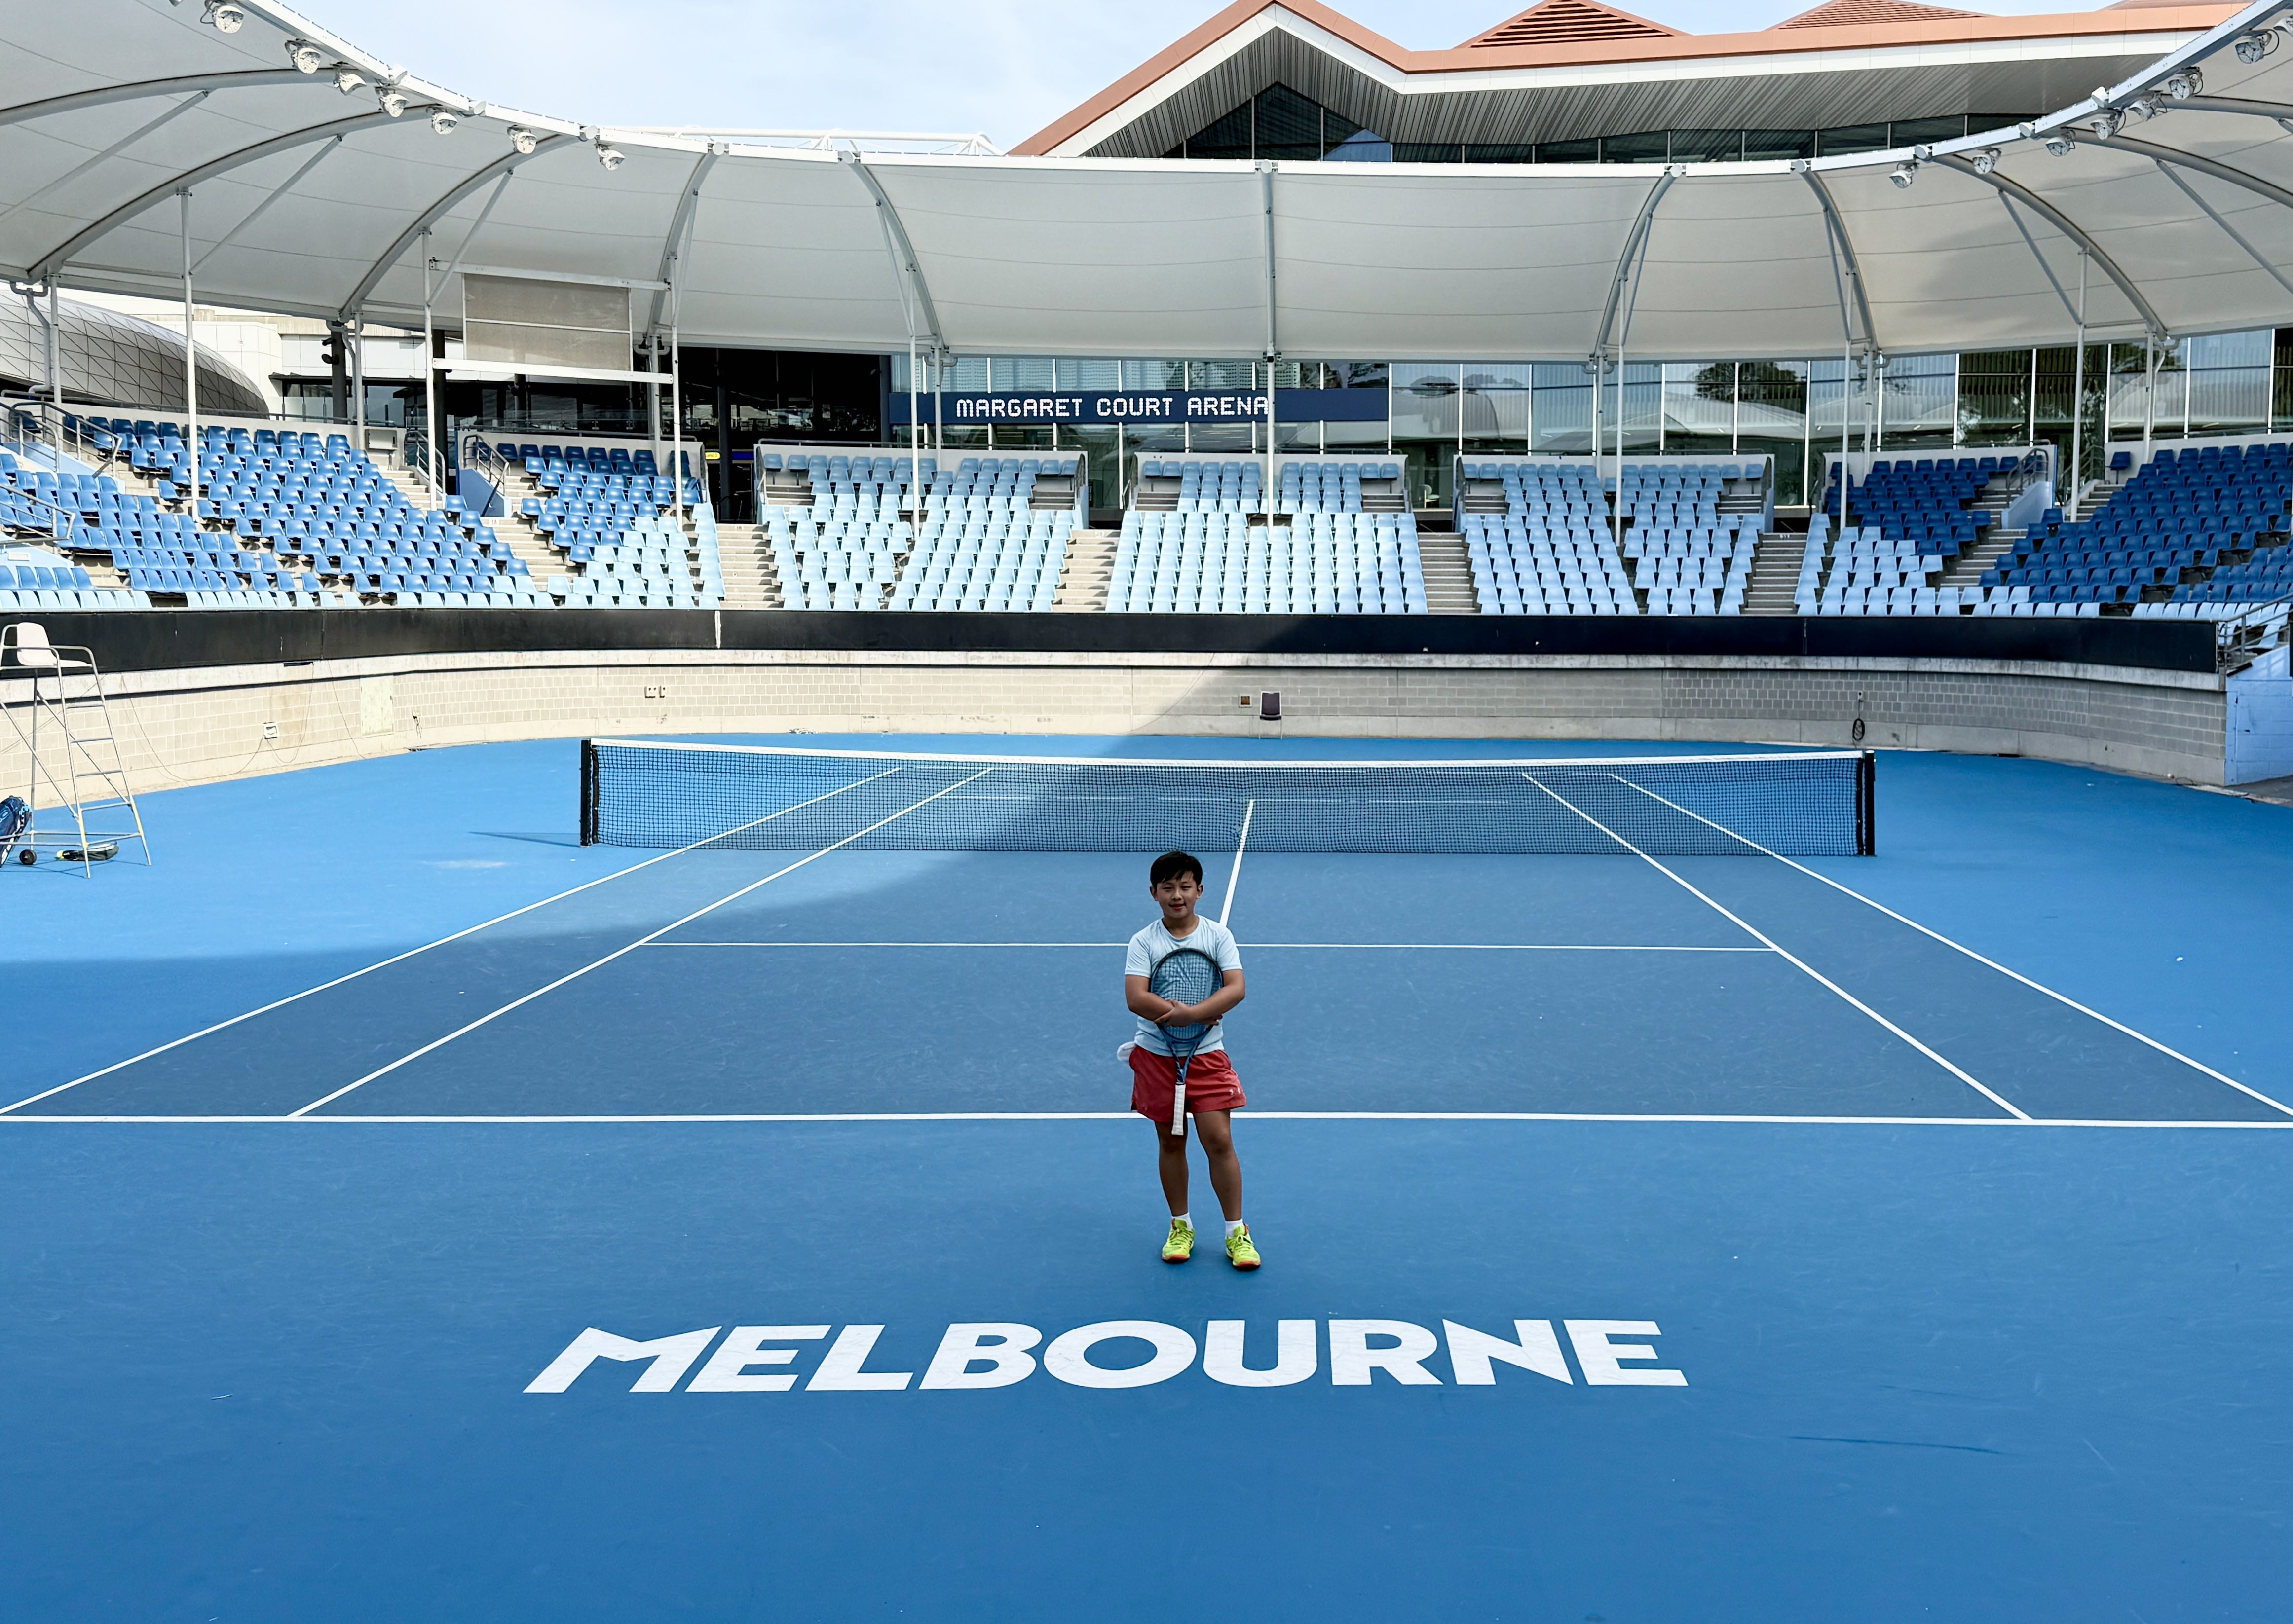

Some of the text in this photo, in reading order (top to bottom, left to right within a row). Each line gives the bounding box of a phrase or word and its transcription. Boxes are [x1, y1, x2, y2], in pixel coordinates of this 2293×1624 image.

[956, 396, 1268, 417] MARGARET COURT ARENA
[523, 1319, 1688, 1393] MELBOURNE
